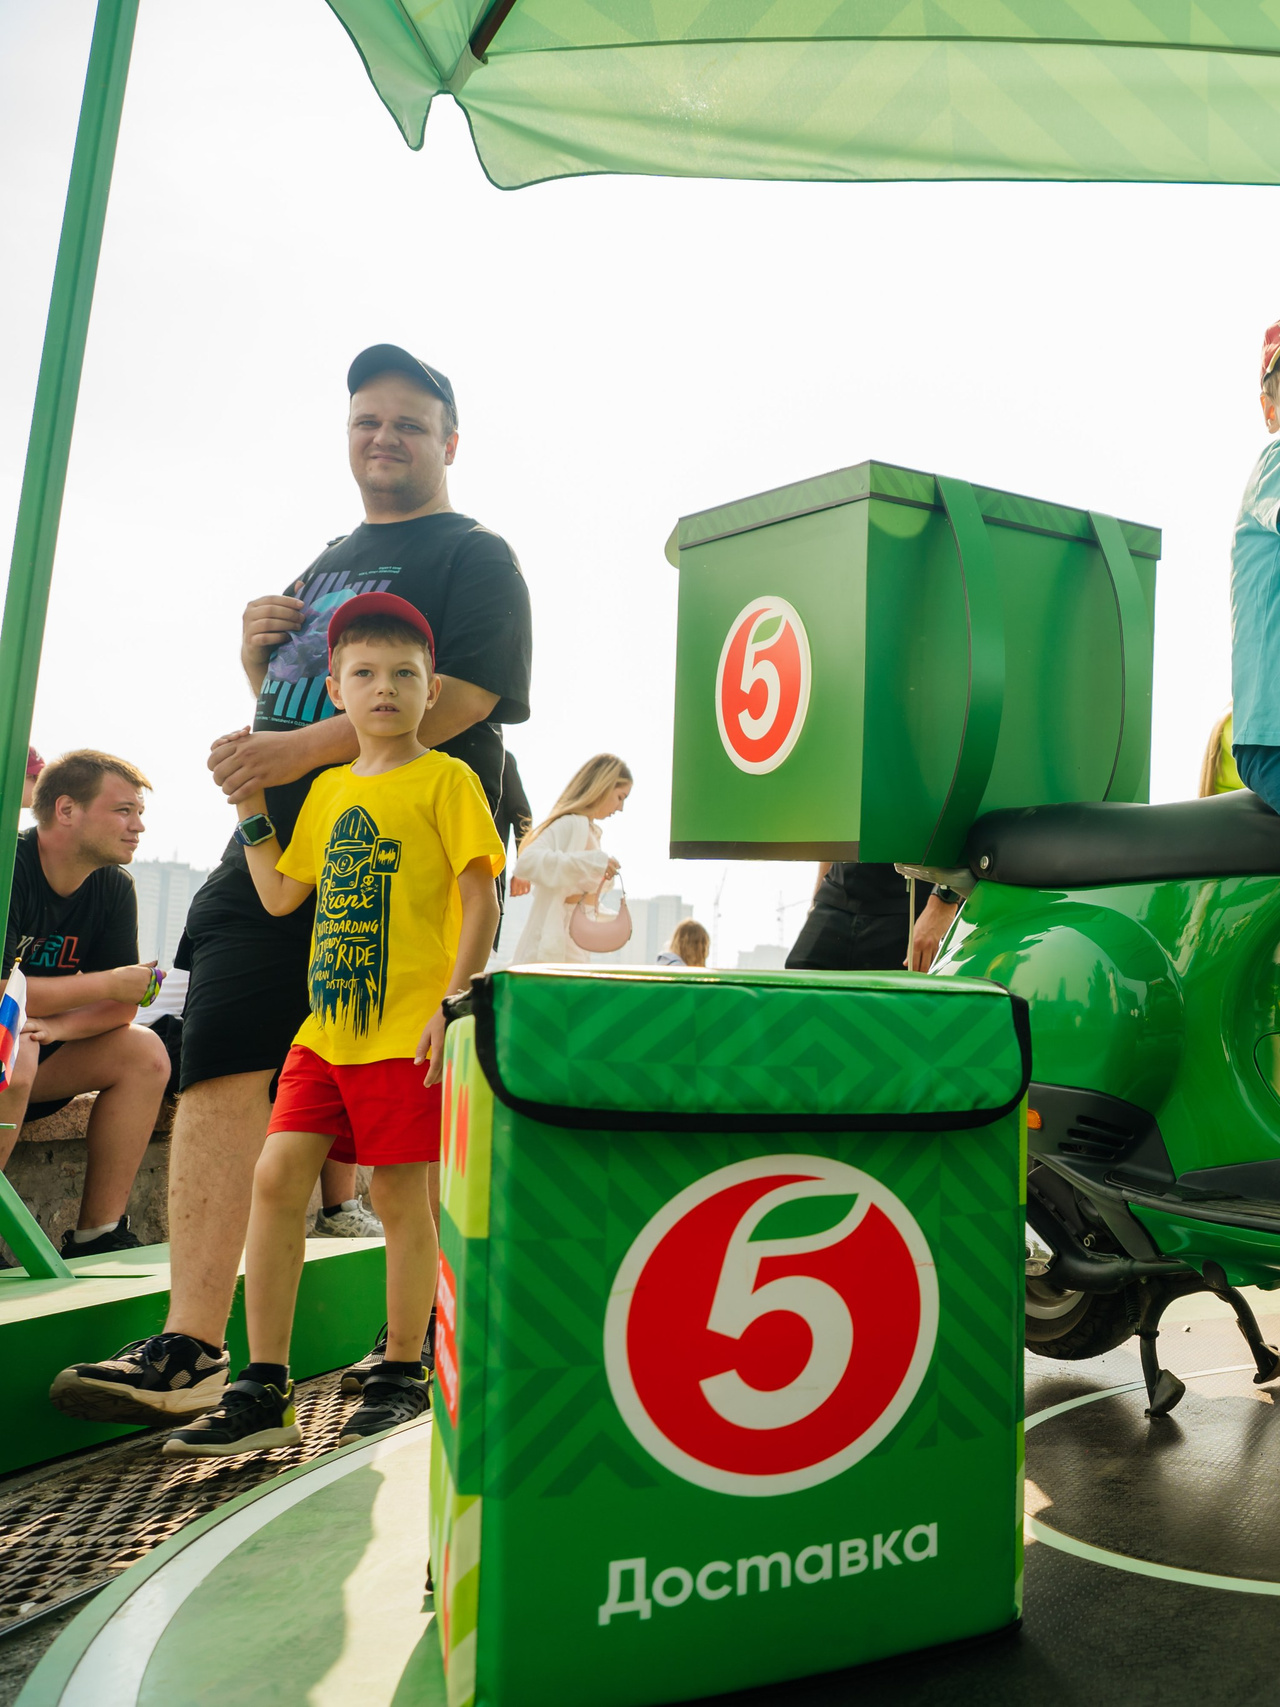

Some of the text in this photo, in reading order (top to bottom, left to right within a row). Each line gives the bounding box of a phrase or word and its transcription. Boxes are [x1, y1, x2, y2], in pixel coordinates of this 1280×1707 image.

[738, 612, 788, 741] 5
[319, 879, 376, 919] Bronx
[336, 943, 378, 971] RIDE
[699, 1183, 868, 1431] 5
[598, 1522, 939, 1626] Доставка
